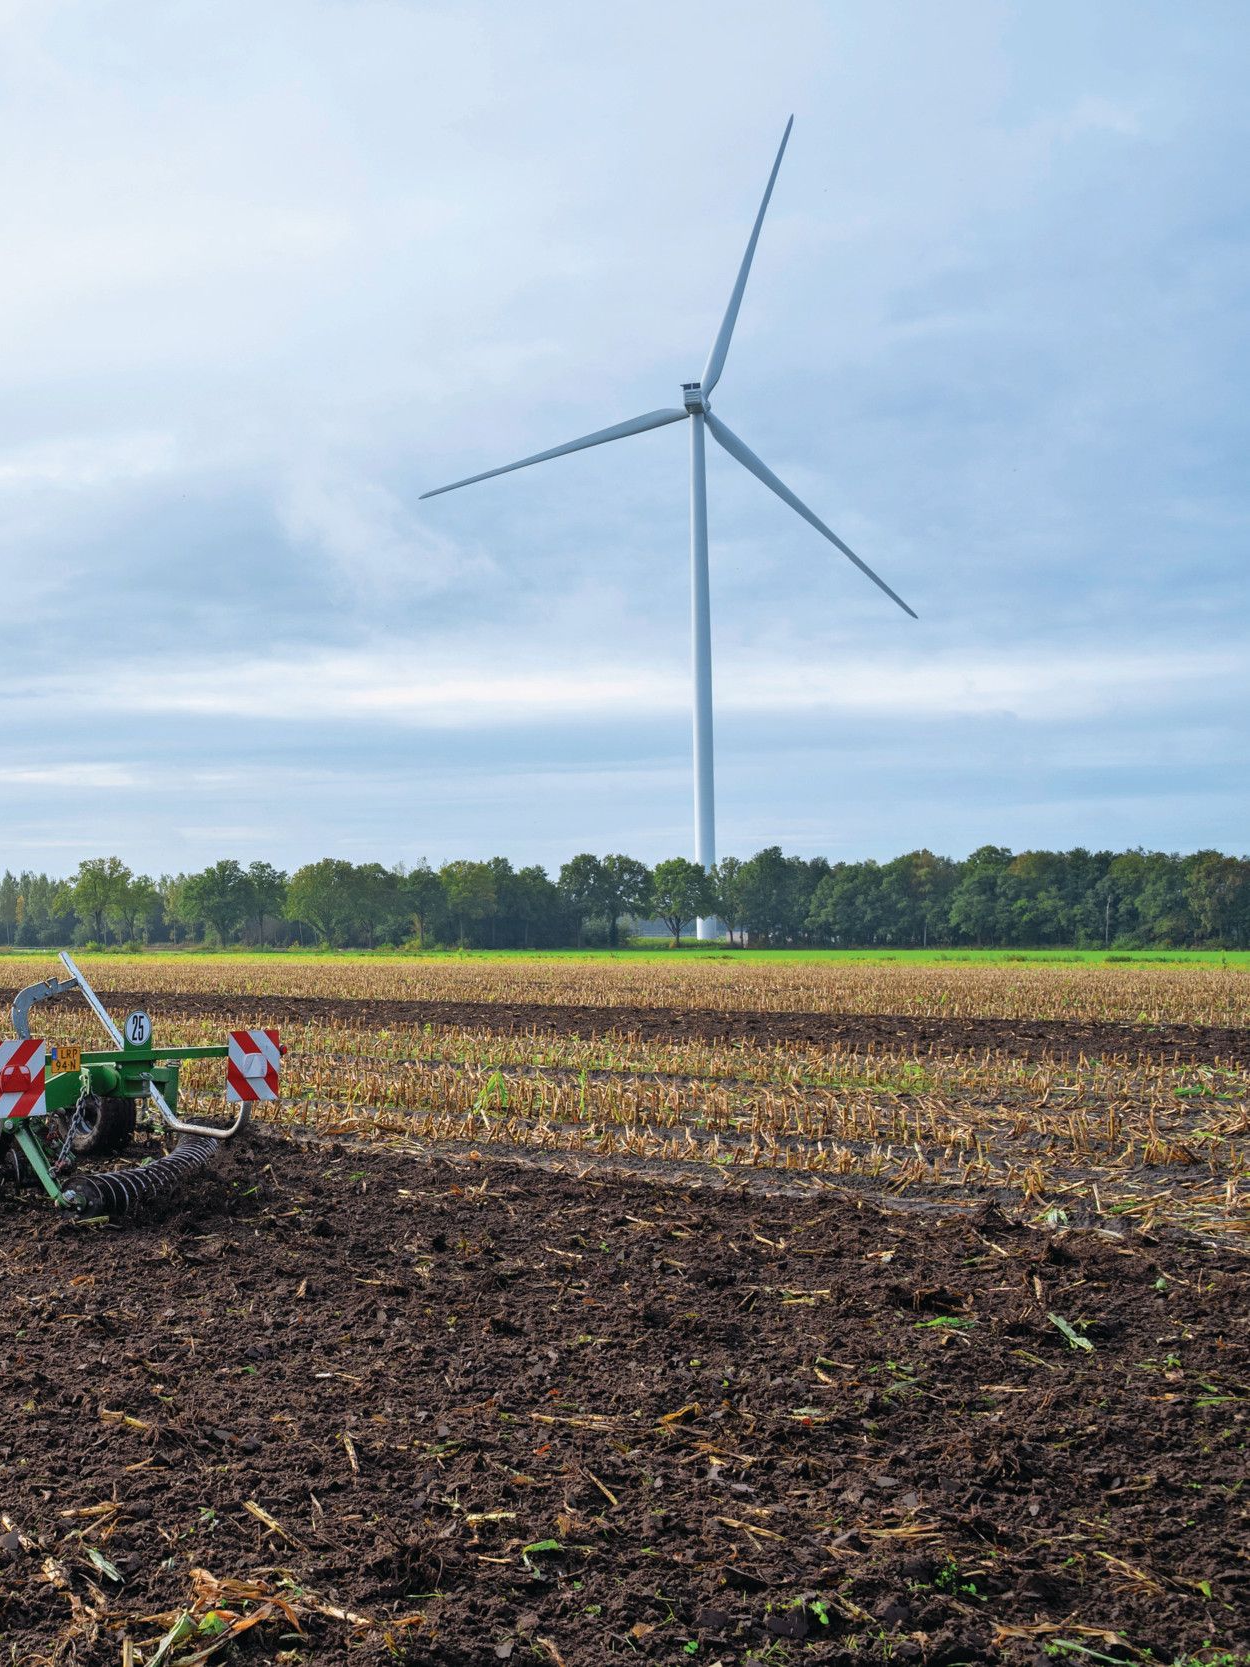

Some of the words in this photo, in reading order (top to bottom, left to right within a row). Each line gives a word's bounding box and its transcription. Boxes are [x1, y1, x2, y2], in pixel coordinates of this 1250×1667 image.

[132, 1014, 145, 1041] 25
[60, 1048, 78, 1059] LRP
[55, 1059, 77, 1071] 94-N
